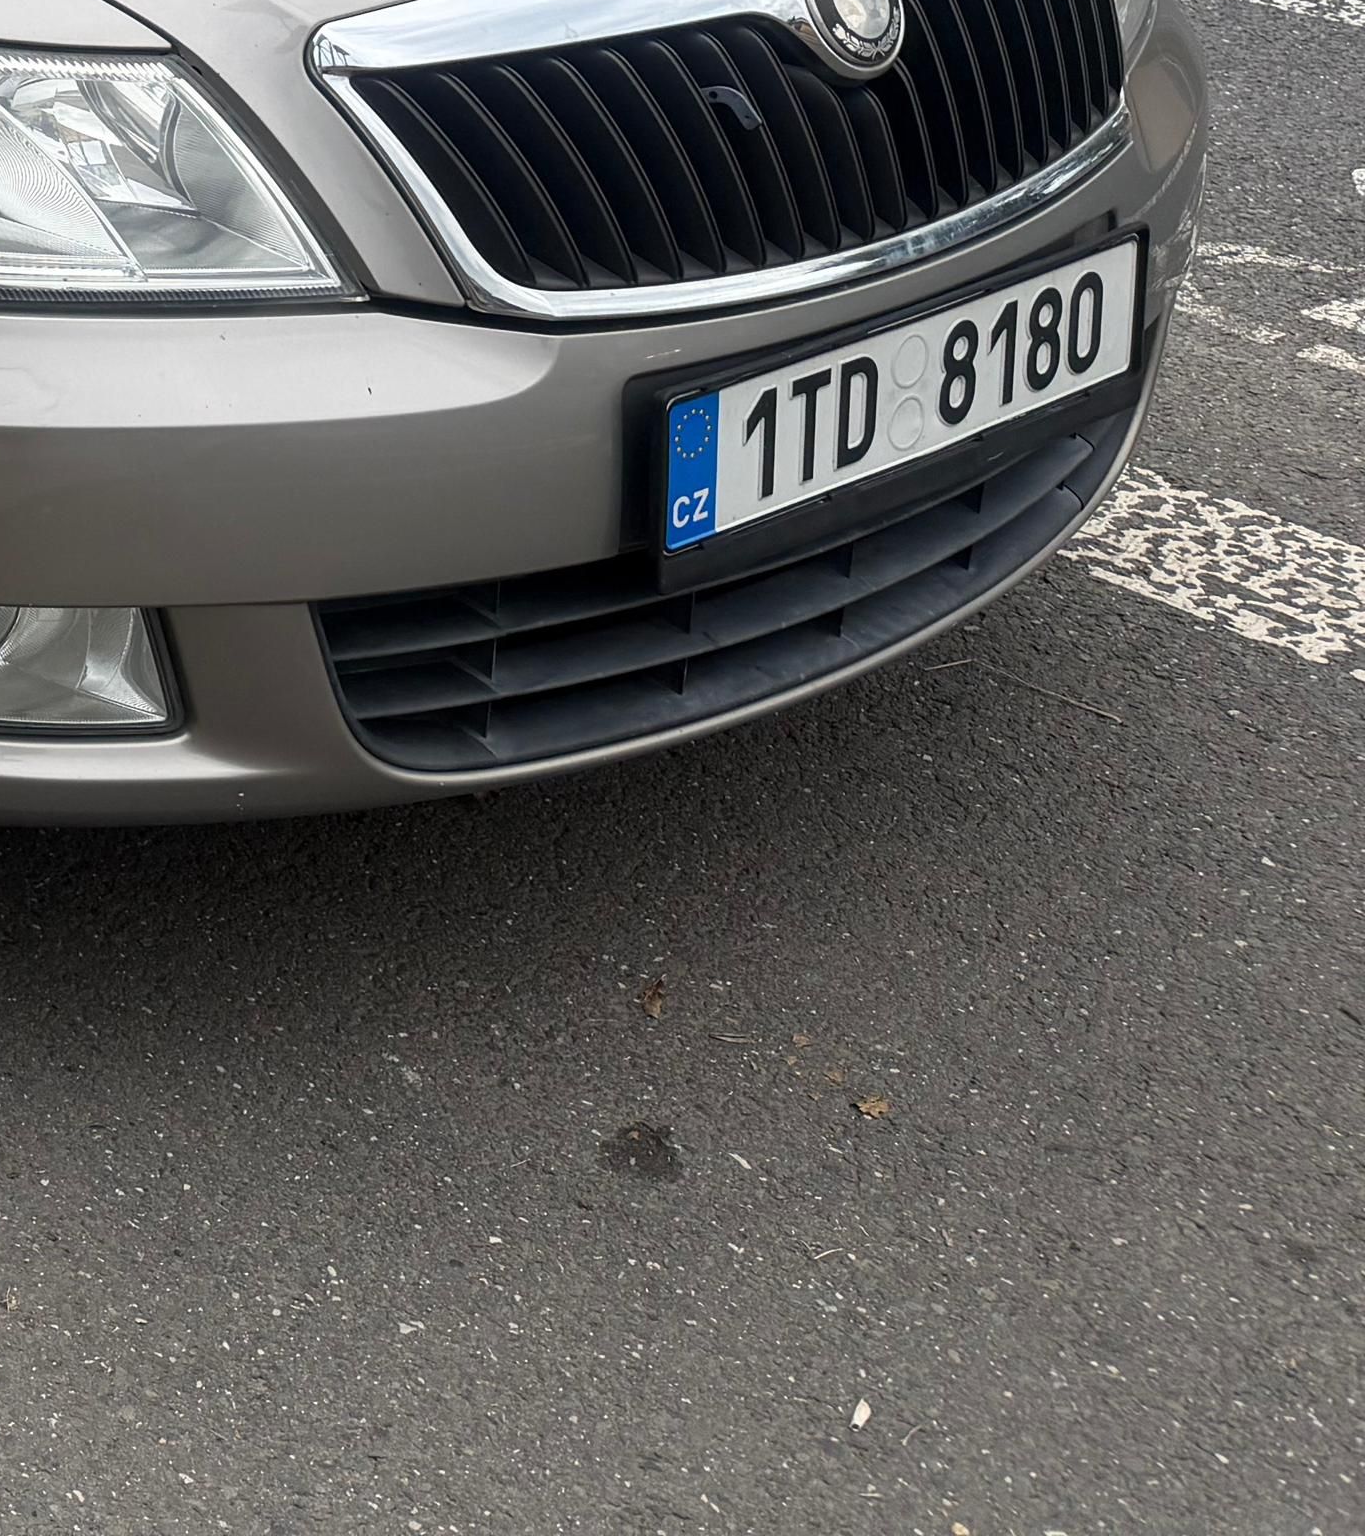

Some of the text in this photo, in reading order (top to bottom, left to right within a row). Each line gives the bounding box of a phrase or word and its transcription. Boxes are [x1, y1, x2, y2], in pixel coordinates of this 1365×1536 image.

[743, 270, 1105, 499] 1TD 8180
[672, 487, 710, 529] CZ
